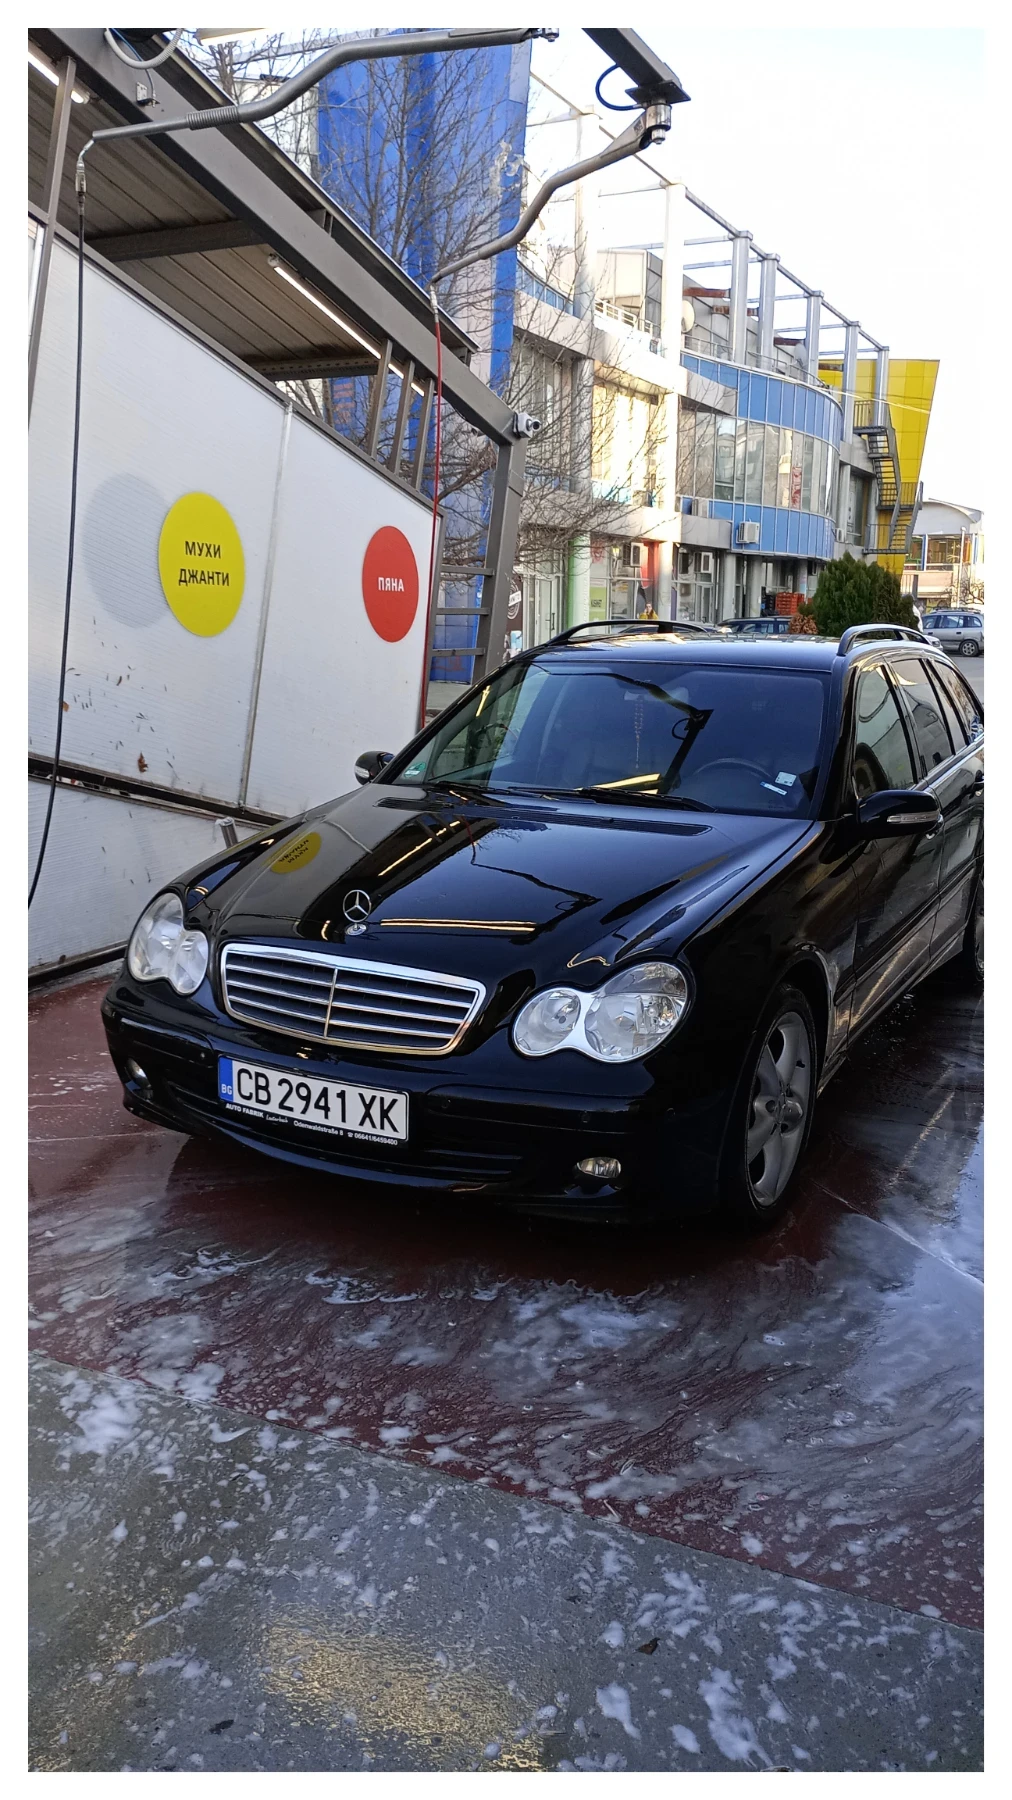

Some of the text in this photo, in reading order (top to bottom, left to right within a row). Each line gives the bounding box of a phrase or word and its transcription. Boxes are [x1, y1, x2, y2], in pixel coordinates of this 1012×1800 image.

[185, 540, 221, 559] МУХИ
[178, 568, 230, 587] ДЖАНТИ
[378, 576, 405, 592] ПЯНА
[221, 1083, 233, 1095] BG
[237, 1068, 400, 1133] CB 2941 XK
[225, 1103, 242, 1112] AUTO
[242, 1107, 264, 1118] FABRIK
